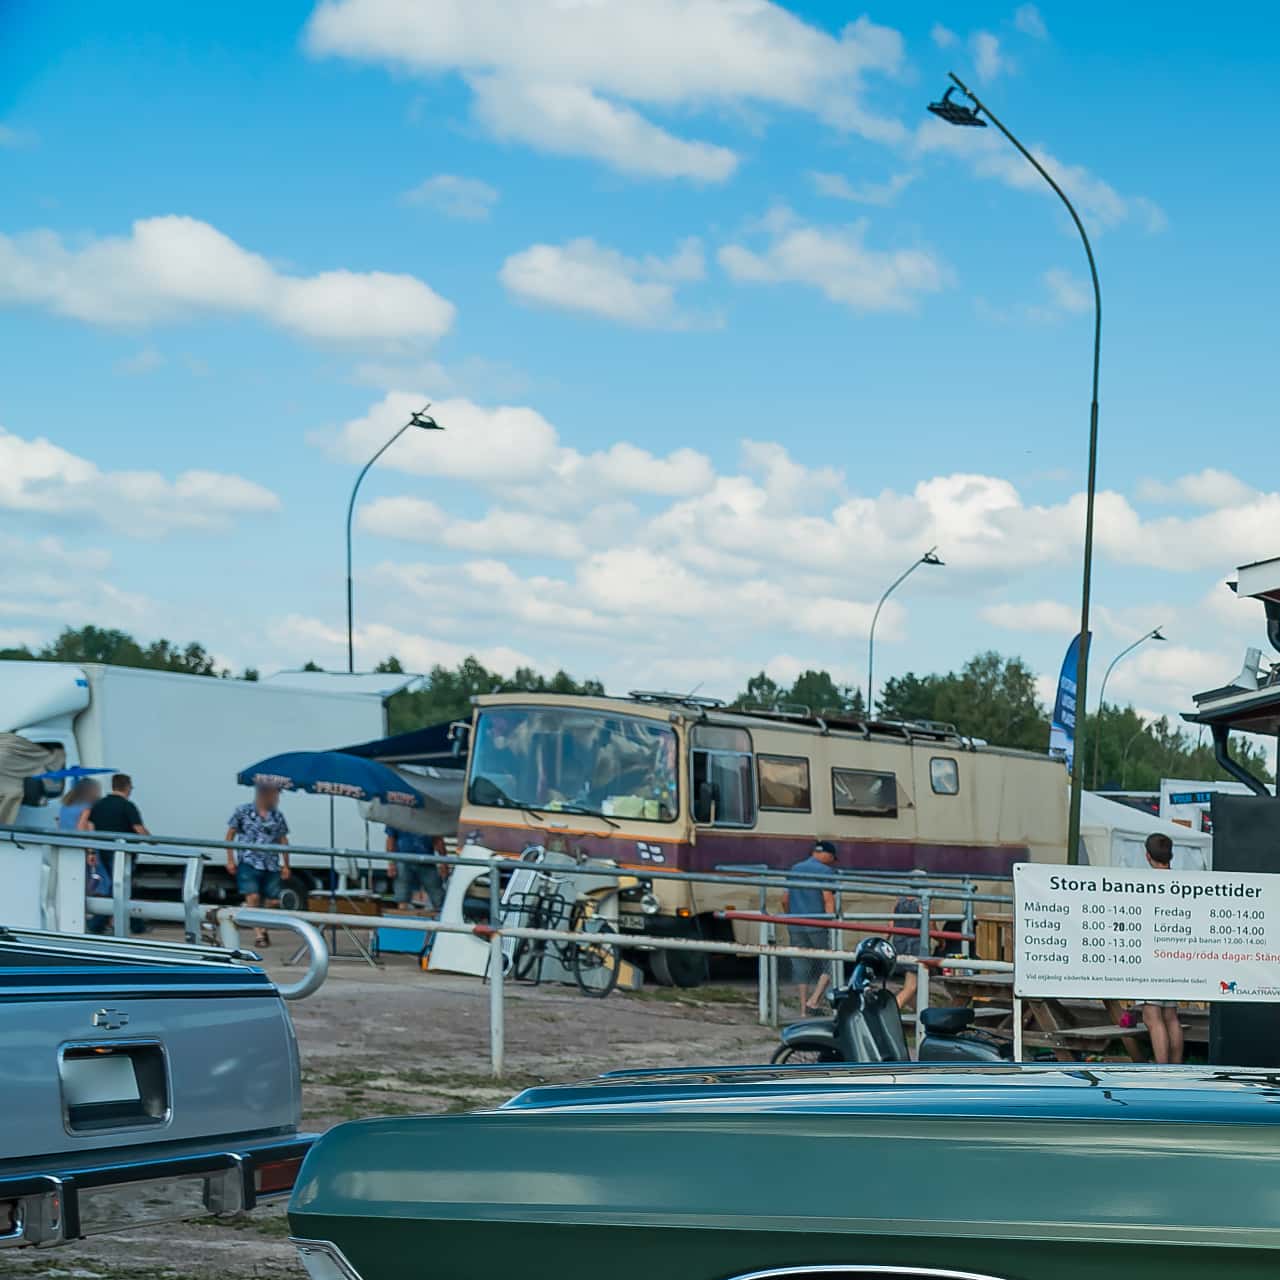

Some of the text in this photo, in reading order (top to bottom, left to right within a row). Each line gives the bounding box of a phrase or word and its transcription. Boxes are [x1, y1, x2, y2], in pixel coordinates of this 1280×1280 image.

[1050, 876, 1263, 899] Stora banans öppettider
[1024, 902, 1070, 915] Måndag
[1082, 904, 1105, 914] 8.00
[1154, 906, 1265, 921] Fredag 8.00-14.00
[1024, 919, 1061, 931] Tisdag
[1082, 920, 1105, 931] 8.00
[1154, 923, 1265, 937] Lördag 8.00-14.00
[1024, 935, 1067, 948] Onsdag
[1082, 937, 1105, 947] 8.00
[1024, 951, 1069, 964] Torsdag
[1082, 953, 1105, 964] 8.00
[1153, 949, 1219, 962] Söndag/röda
[1221, 951, 1253, 963] dagar:
